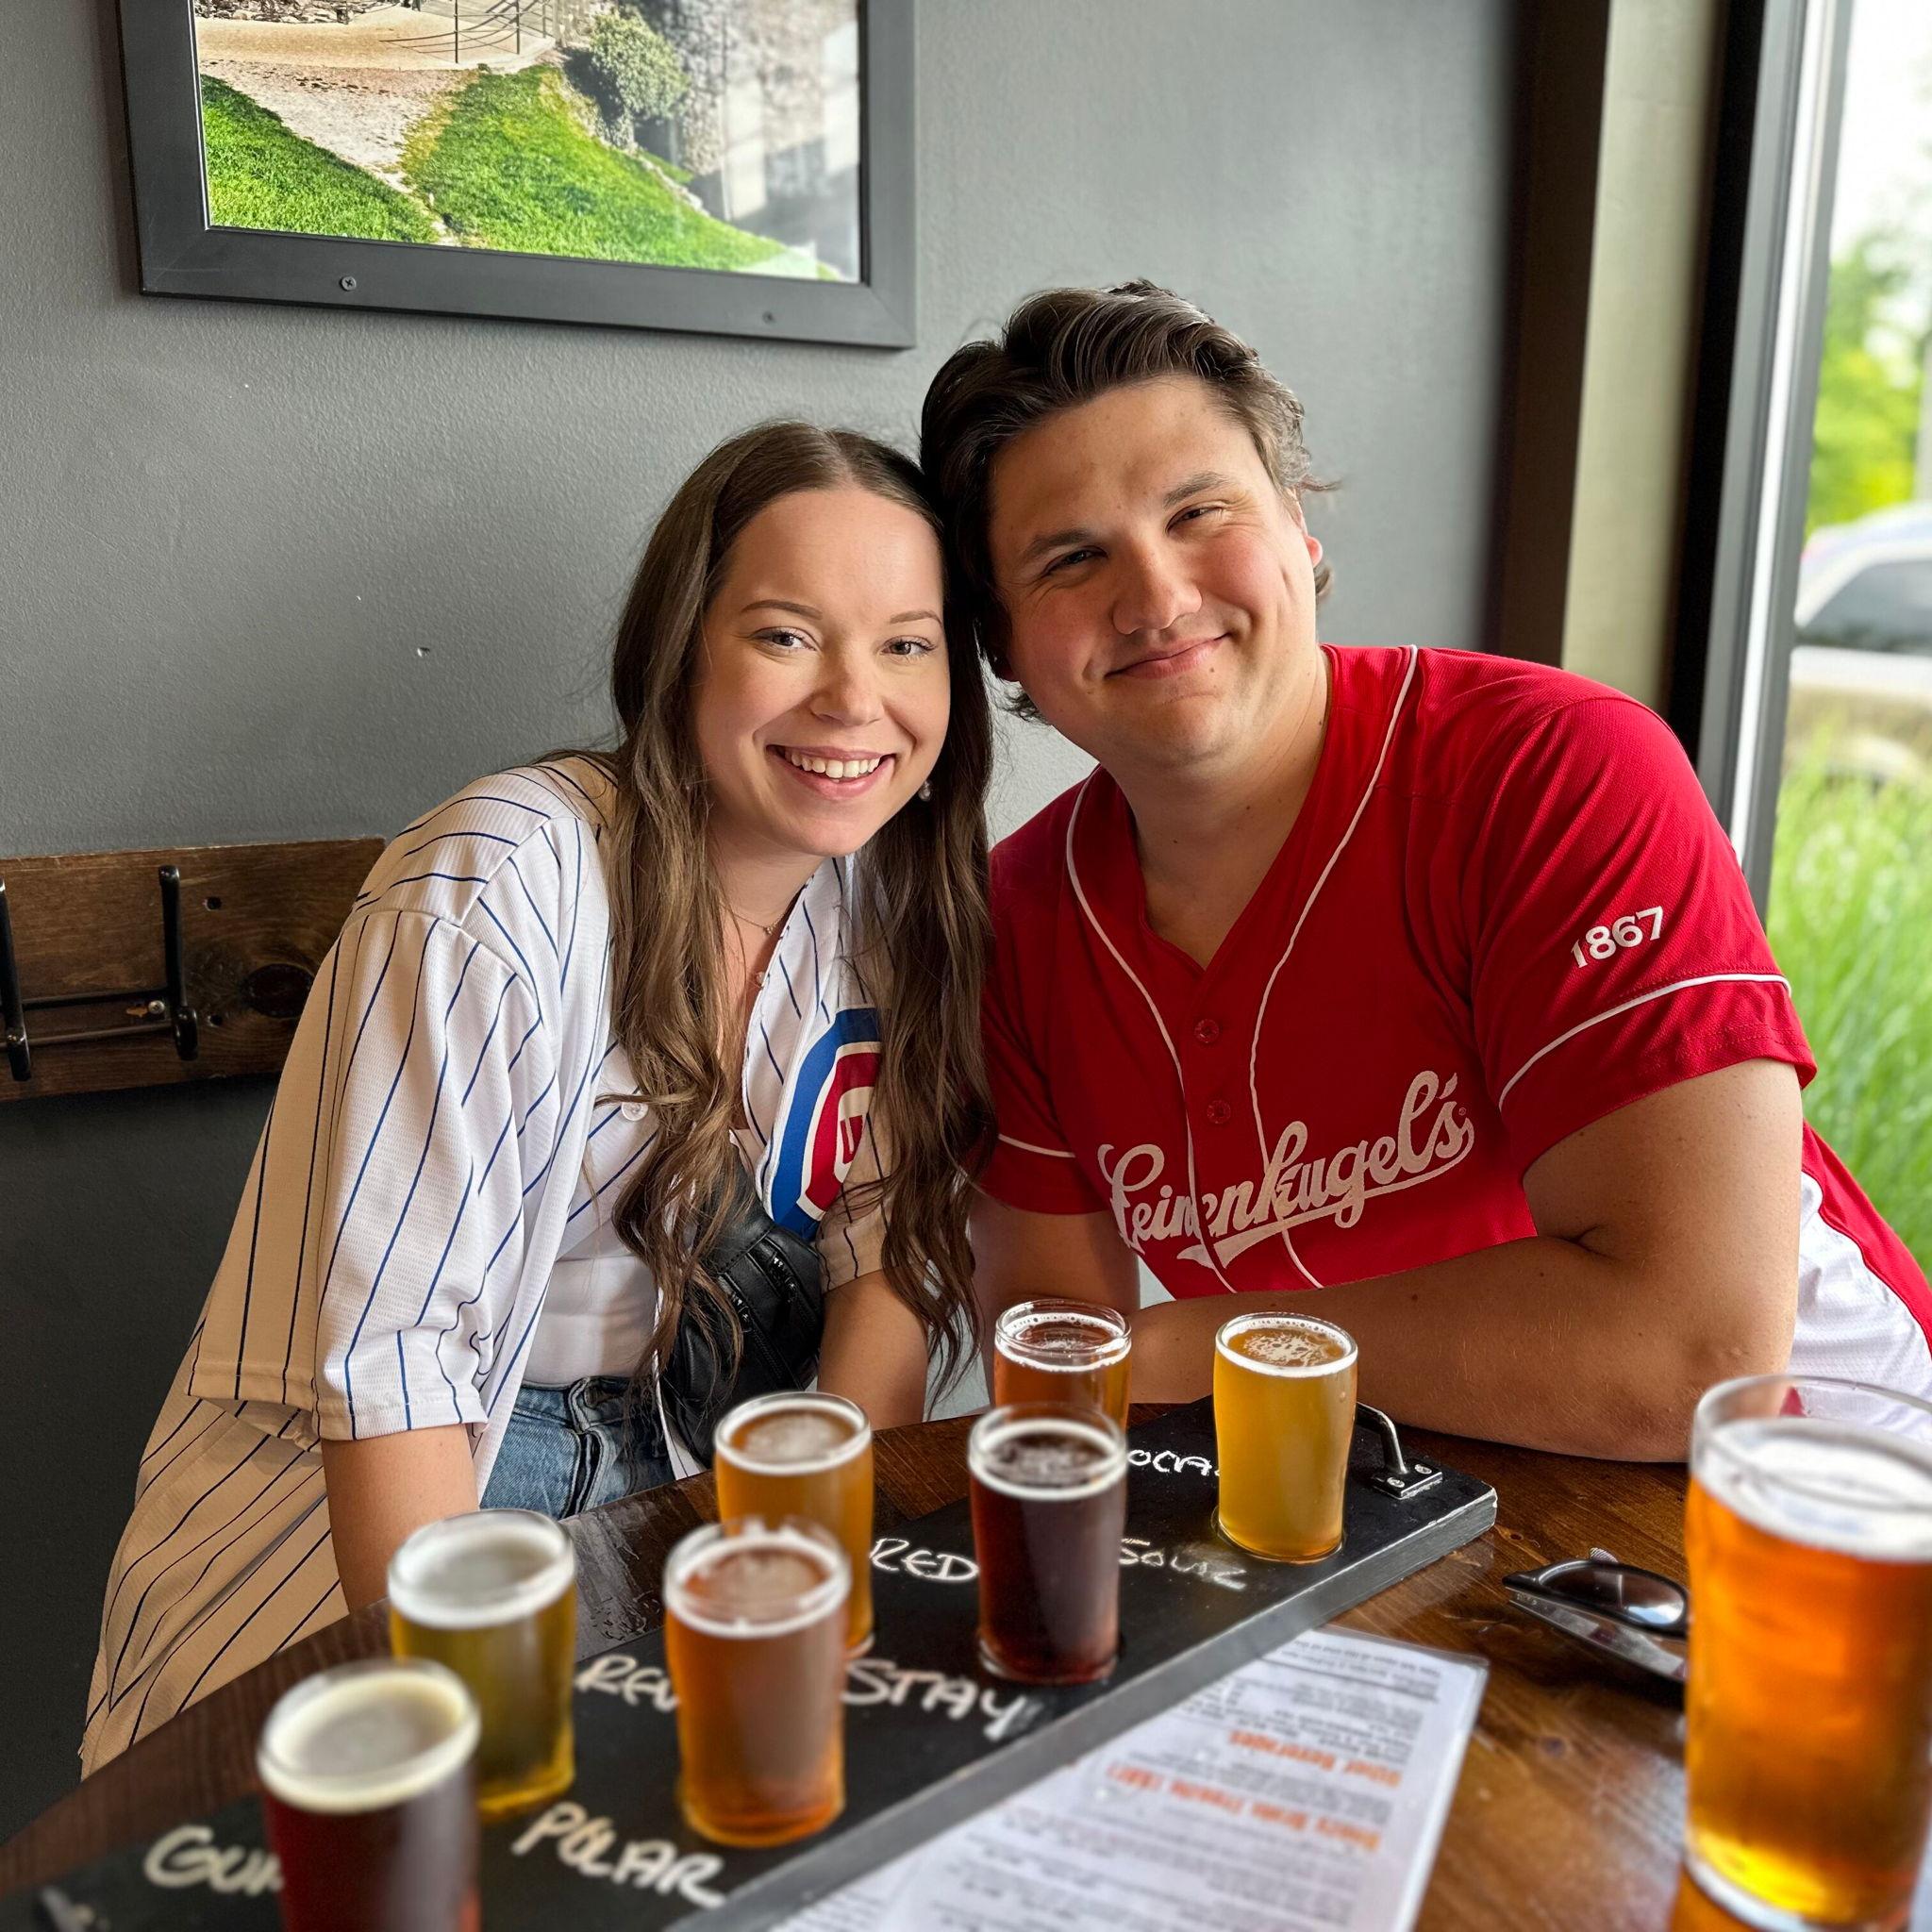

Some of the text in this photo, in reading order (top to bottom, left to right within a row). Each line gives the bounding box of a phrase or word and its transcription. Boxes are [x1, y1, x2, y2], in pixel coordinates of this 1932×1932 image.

[1570, 906, 1663, 968] 1867
[869, 1537, 979, 1582] RED
[840, 1657, 1028, 1742] STAY
[510, 1801, 726, 1909] POLAR
